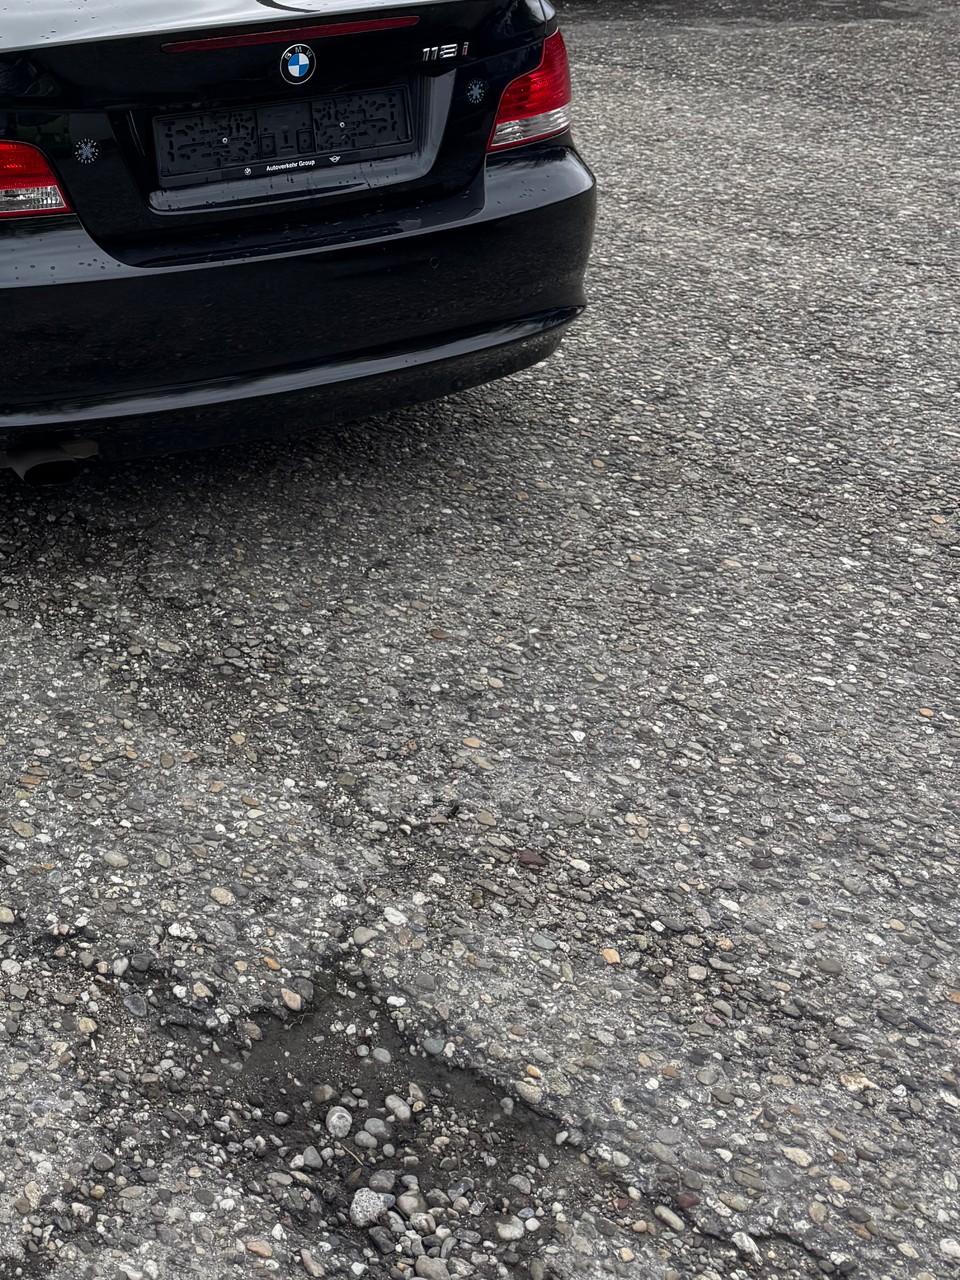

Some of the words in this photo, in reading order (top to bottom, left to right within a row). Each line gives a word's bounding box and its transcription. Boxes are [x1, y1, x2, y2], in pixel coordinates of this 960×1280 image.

[284, 46, 313, 60] BMW
[266, 162, 298, 172] Autoverkehr
[298, 160, 315, 168] Group
